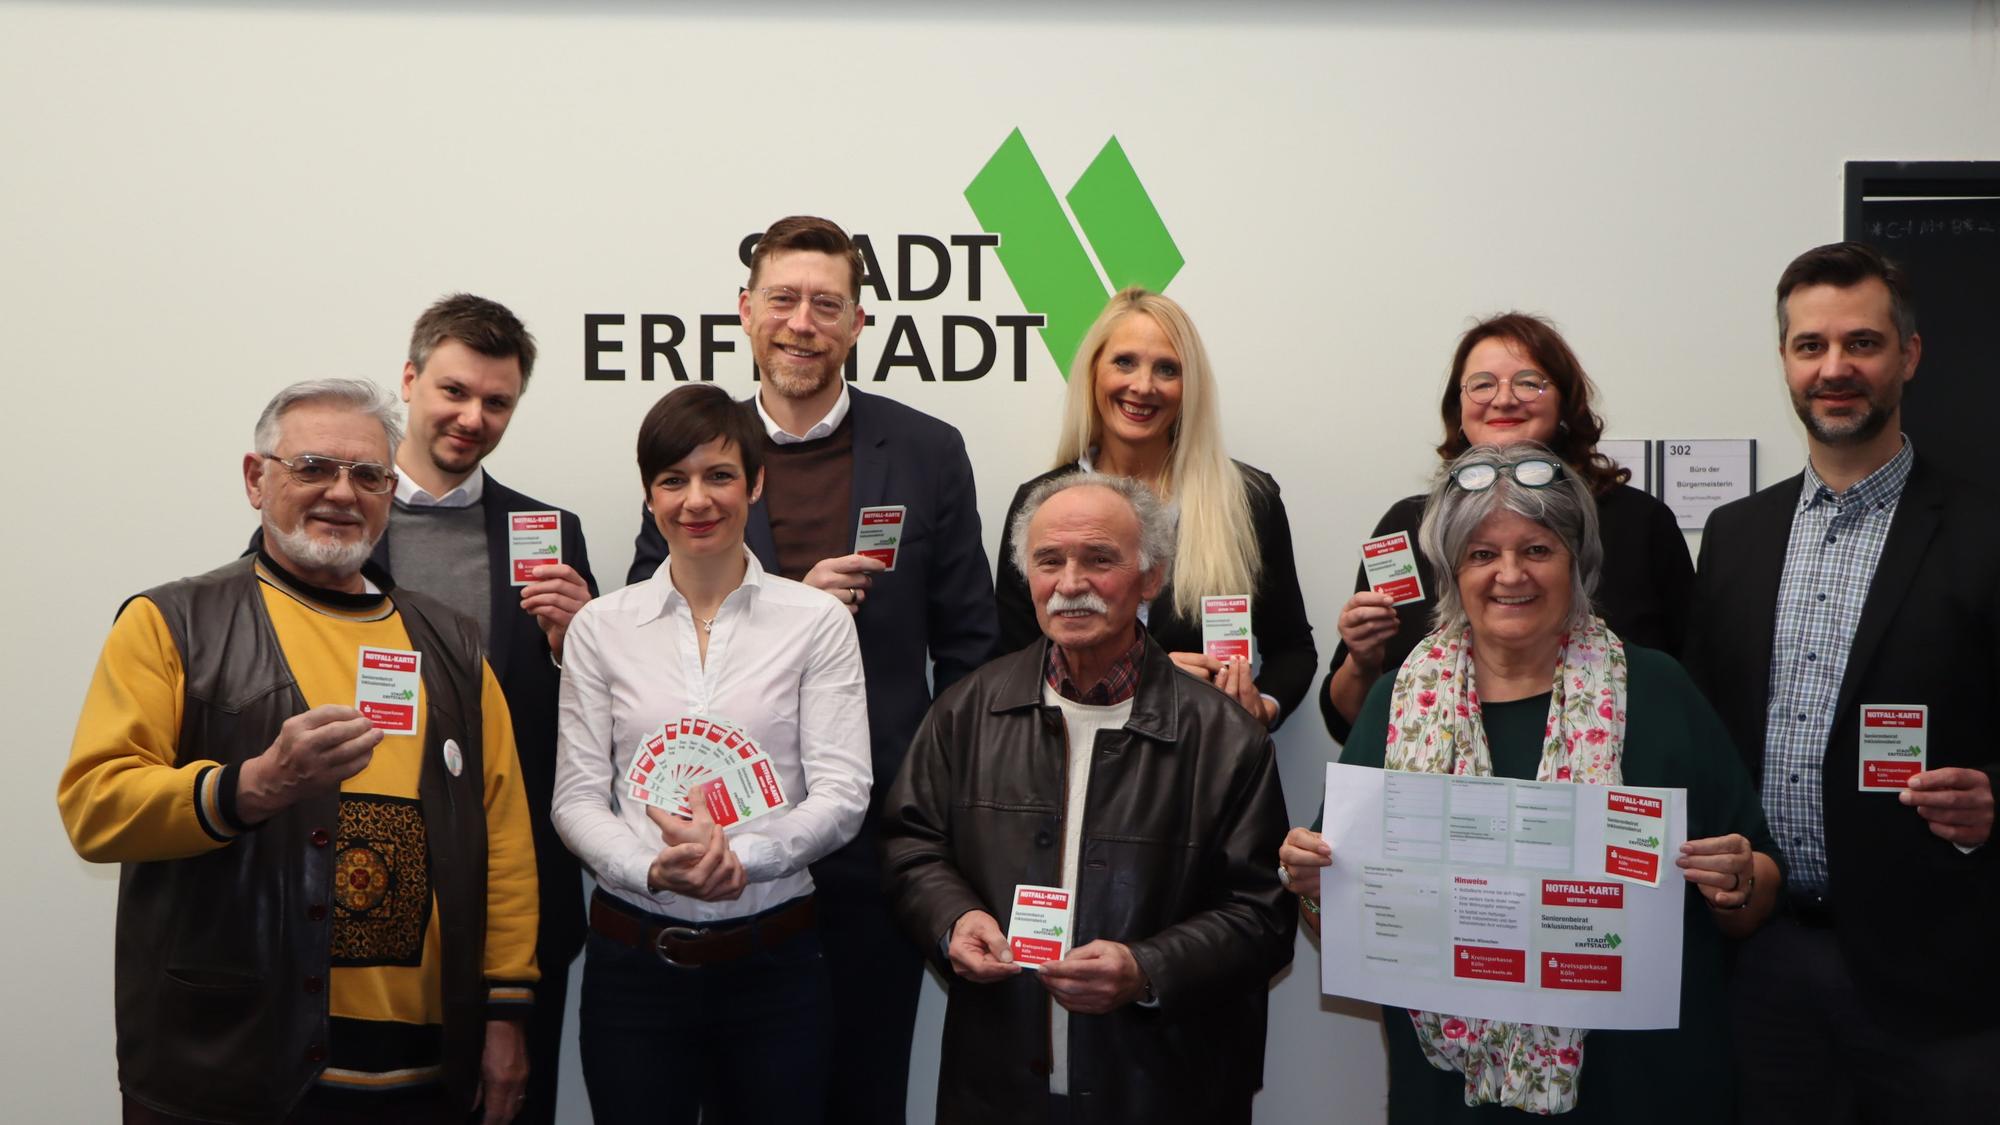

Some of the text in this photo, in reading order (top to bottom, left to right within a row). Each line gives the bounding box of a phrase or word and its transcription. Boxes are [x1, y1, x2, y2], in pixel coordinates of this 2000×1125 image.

[1670, 445, 1691, 456] 302
[1677, 481, 1733, 489] Bürgermeisterin
[365, 652, 415, 664] NOTFALL-KARTE
[1867, 711, 1920, 719] NOTFALL-KARTE
[1610, 794, 1660, 808] NOTFALL-KARTE
[1454, 876, 1488, 886] Hinweise
[1545, 883, 1620, 896] NOTFALL-KARTE
[1020, 891, 1067, 902] NOTFALL-KARTE
[1541, 914, 1589, 923] Seniorenbeirat
[1541, 923, 1593, 931] Inklusionsbeirat
[1470, 955, 1513, 963] Kreissparkasse
[1560, 962, 1608, 971] Kreissparkasse
